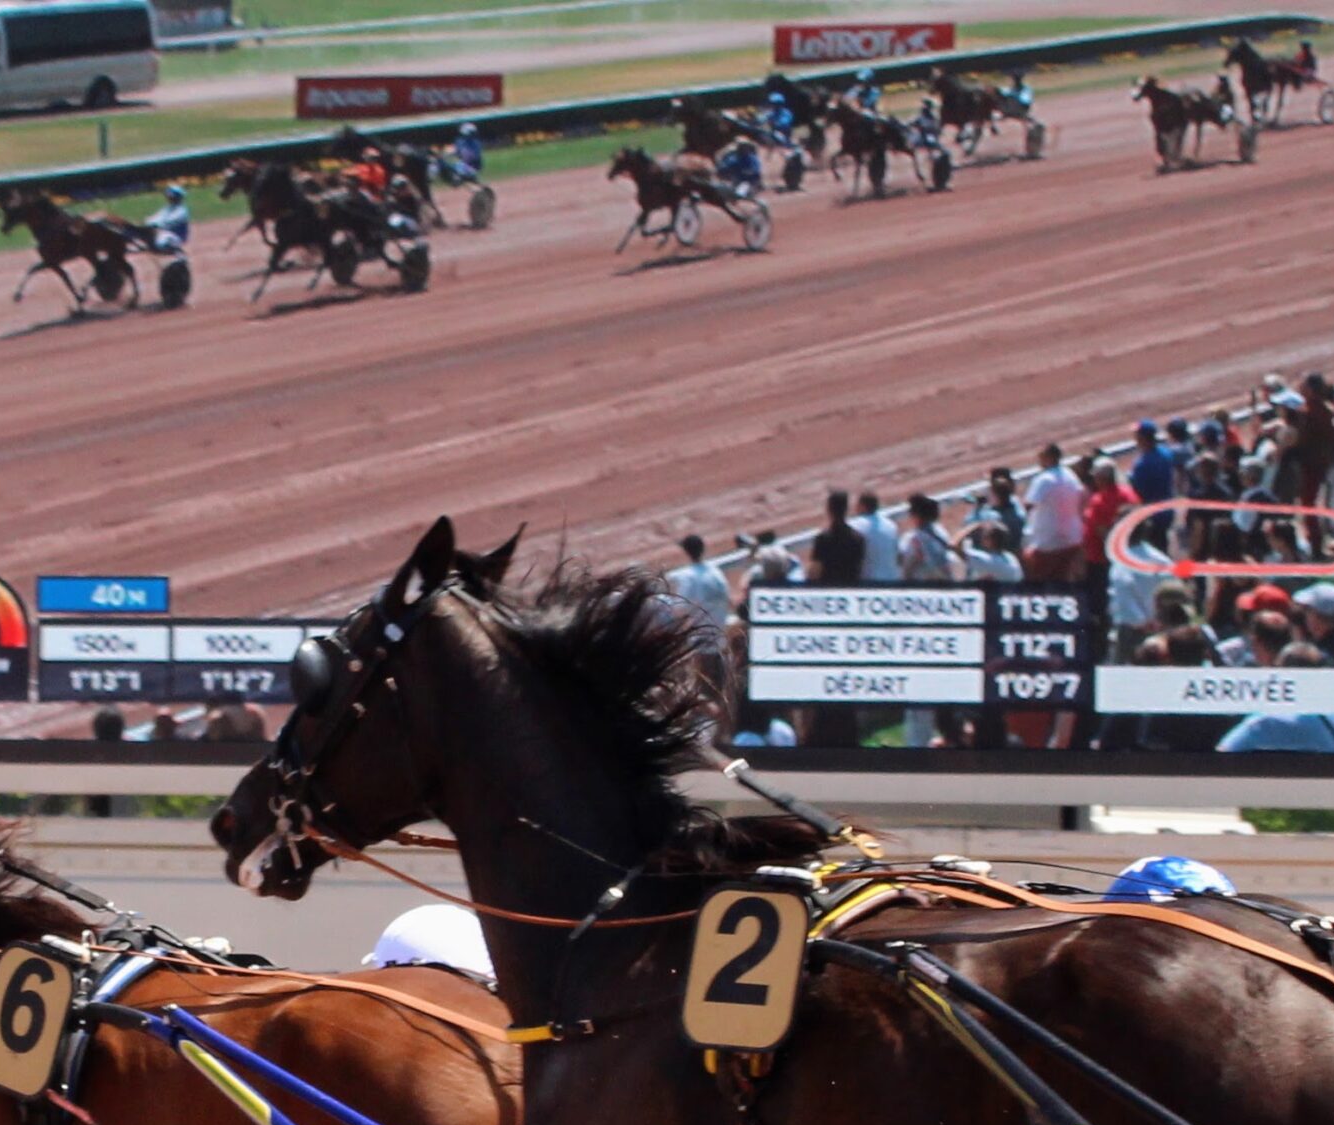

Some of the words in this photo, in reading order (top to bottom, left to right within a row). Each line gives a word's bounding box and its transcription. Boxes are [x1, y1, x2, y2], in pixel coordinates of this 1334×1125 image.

[758, 596, 849, 615] DERNIER
[856, 596, 977, 616] TOURNANT
[774, 635, 840, 654] LIGNE
[846, 635, 895, 654] D'EN
[902, 636, 958, 655] FACE
[824, 671, 909, 694] DÉPART
[1183, 676, 1296, 702] ARRIVÉE
[703, 896, 781, 1006] 2
[0, 957, 55, 1054] 6
